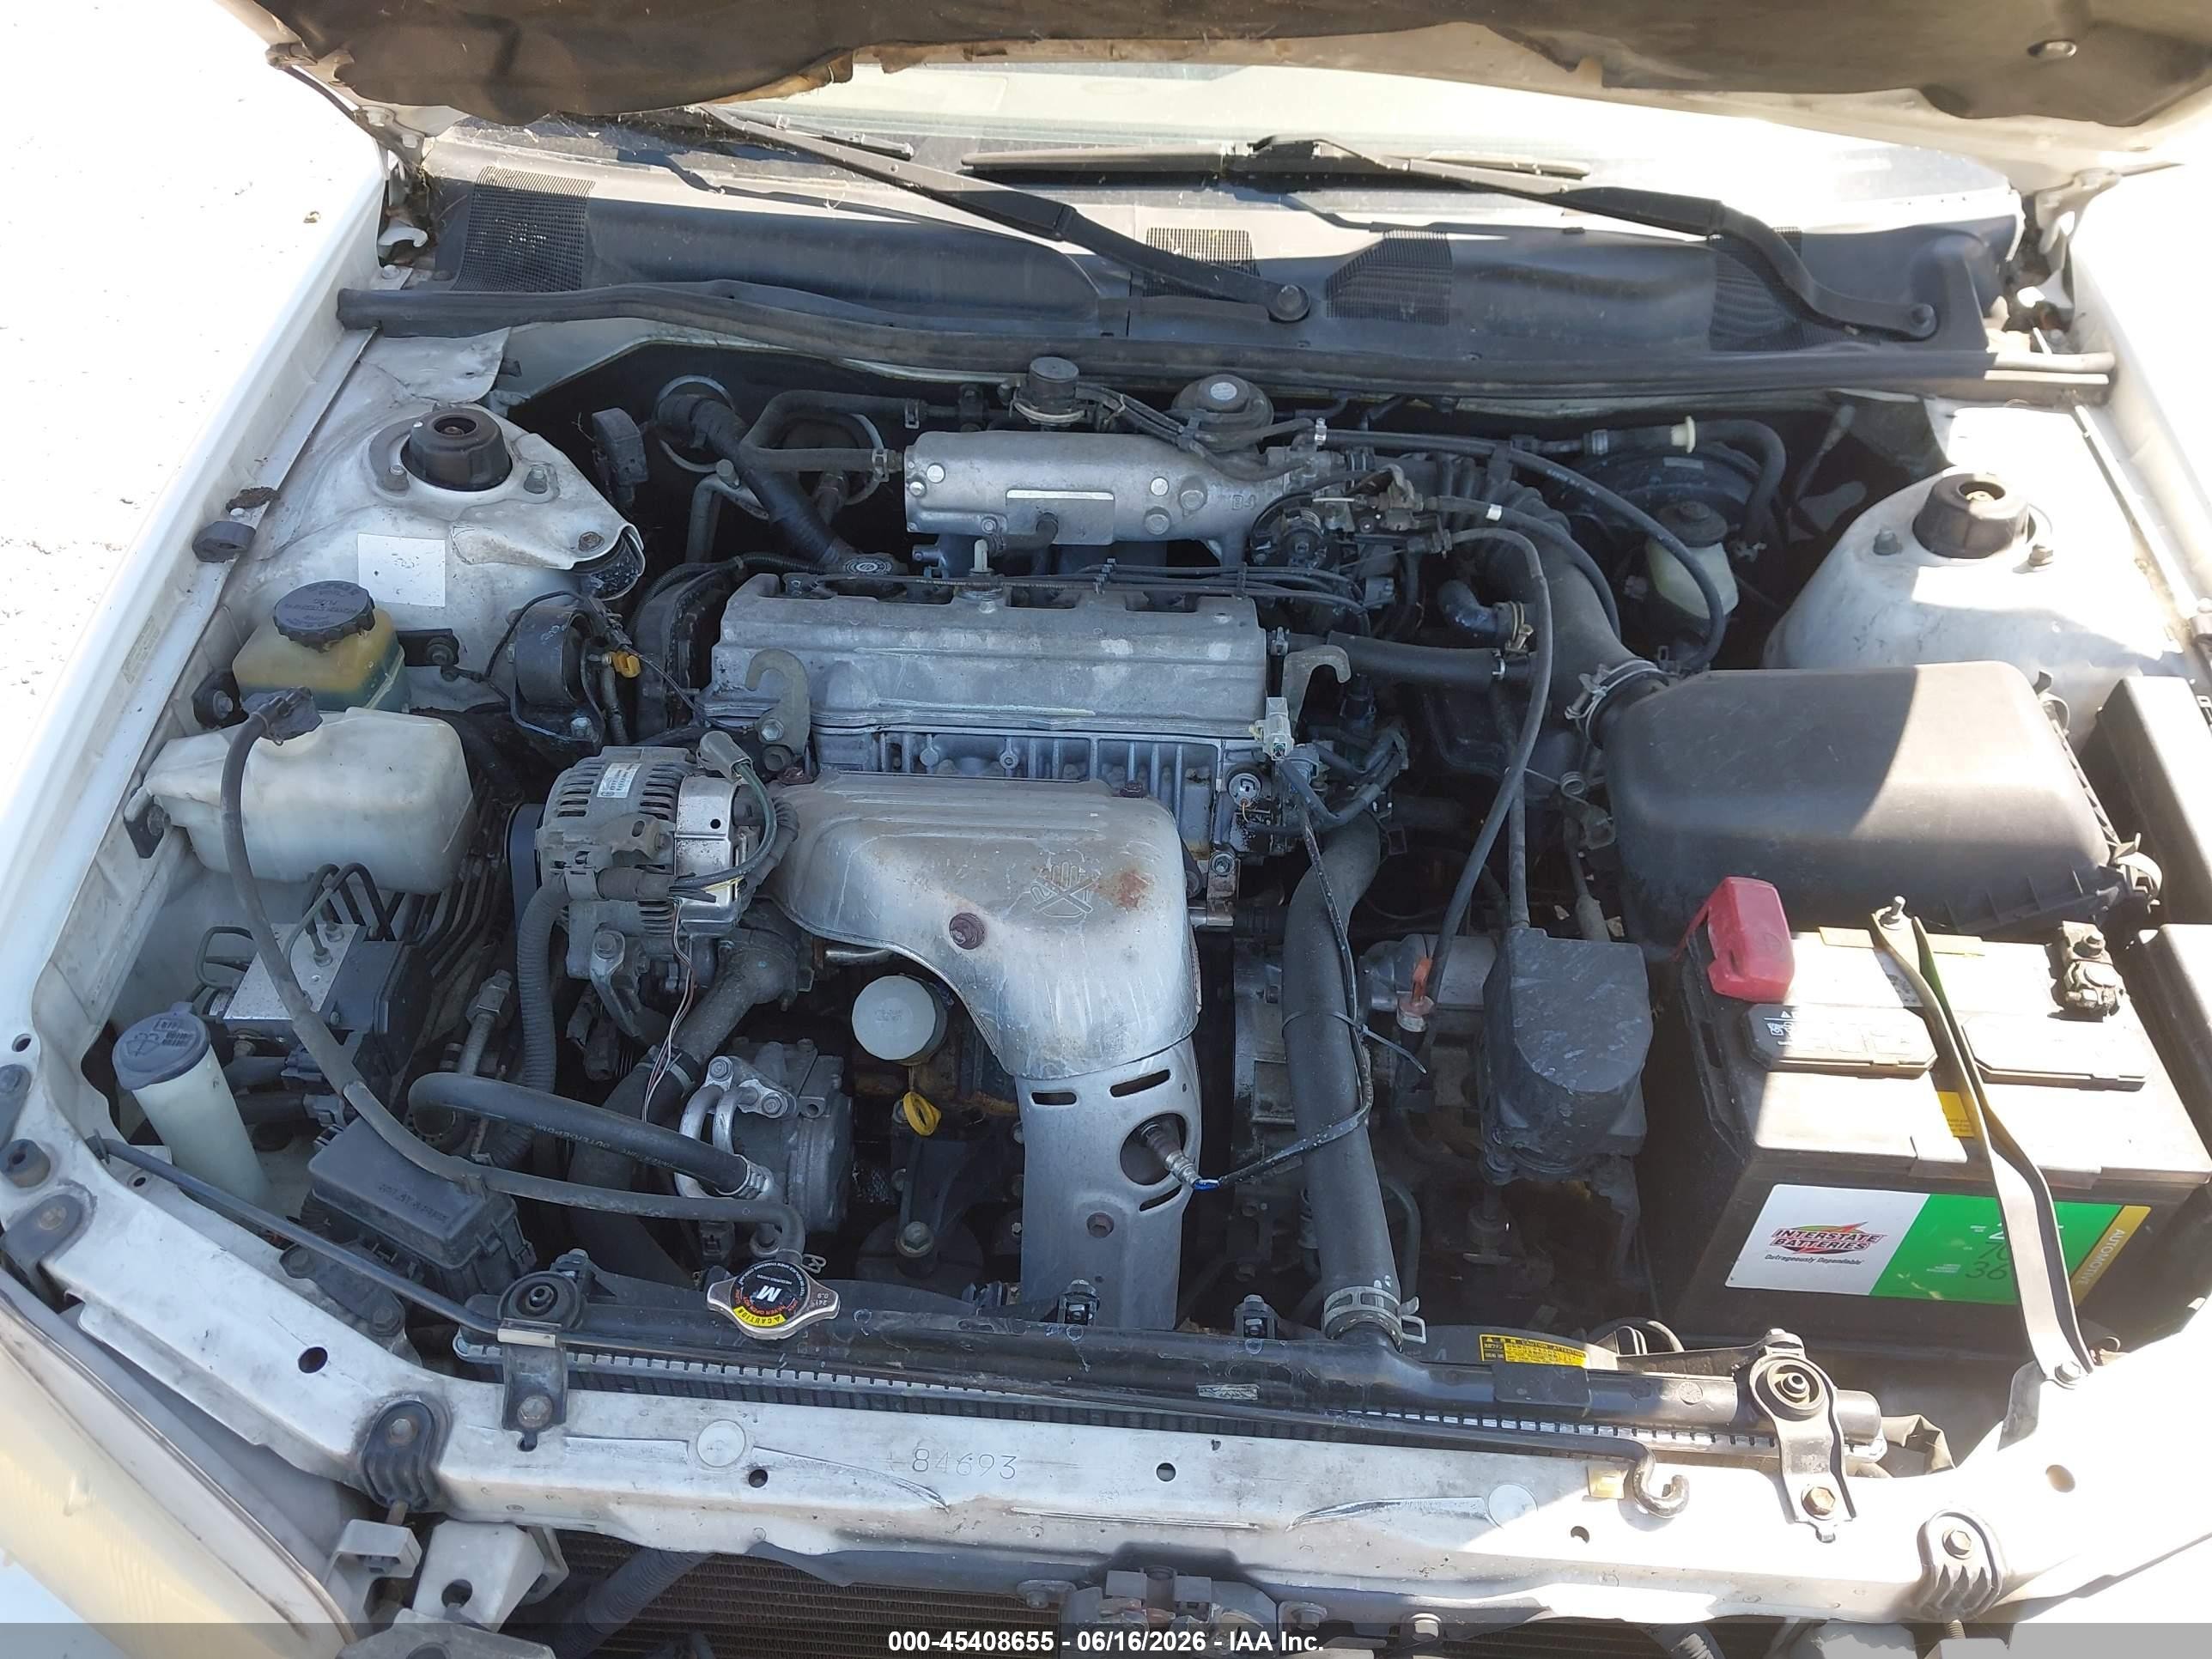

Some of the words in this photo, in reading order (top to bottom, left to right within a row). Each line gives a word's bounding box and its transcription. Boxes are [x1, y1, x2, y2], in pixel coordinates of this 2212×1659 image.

[1776, 1230, 1881, 1243] INTERSTATE
[1774, 1238, 1869, 1250] BATTERIES
[1765, 1254, 1815, 1264] Outrageously
[1817, 1256, 1862, 1265] Dependable
[2075, 1229, 2125, 1285] AUTOMOTIVE
[738, 1309, 772, 1324] CAUTION
[1522, 1340, 1548, 1349] CAUTION
[912, 1448, 1018, 1480] 84693
